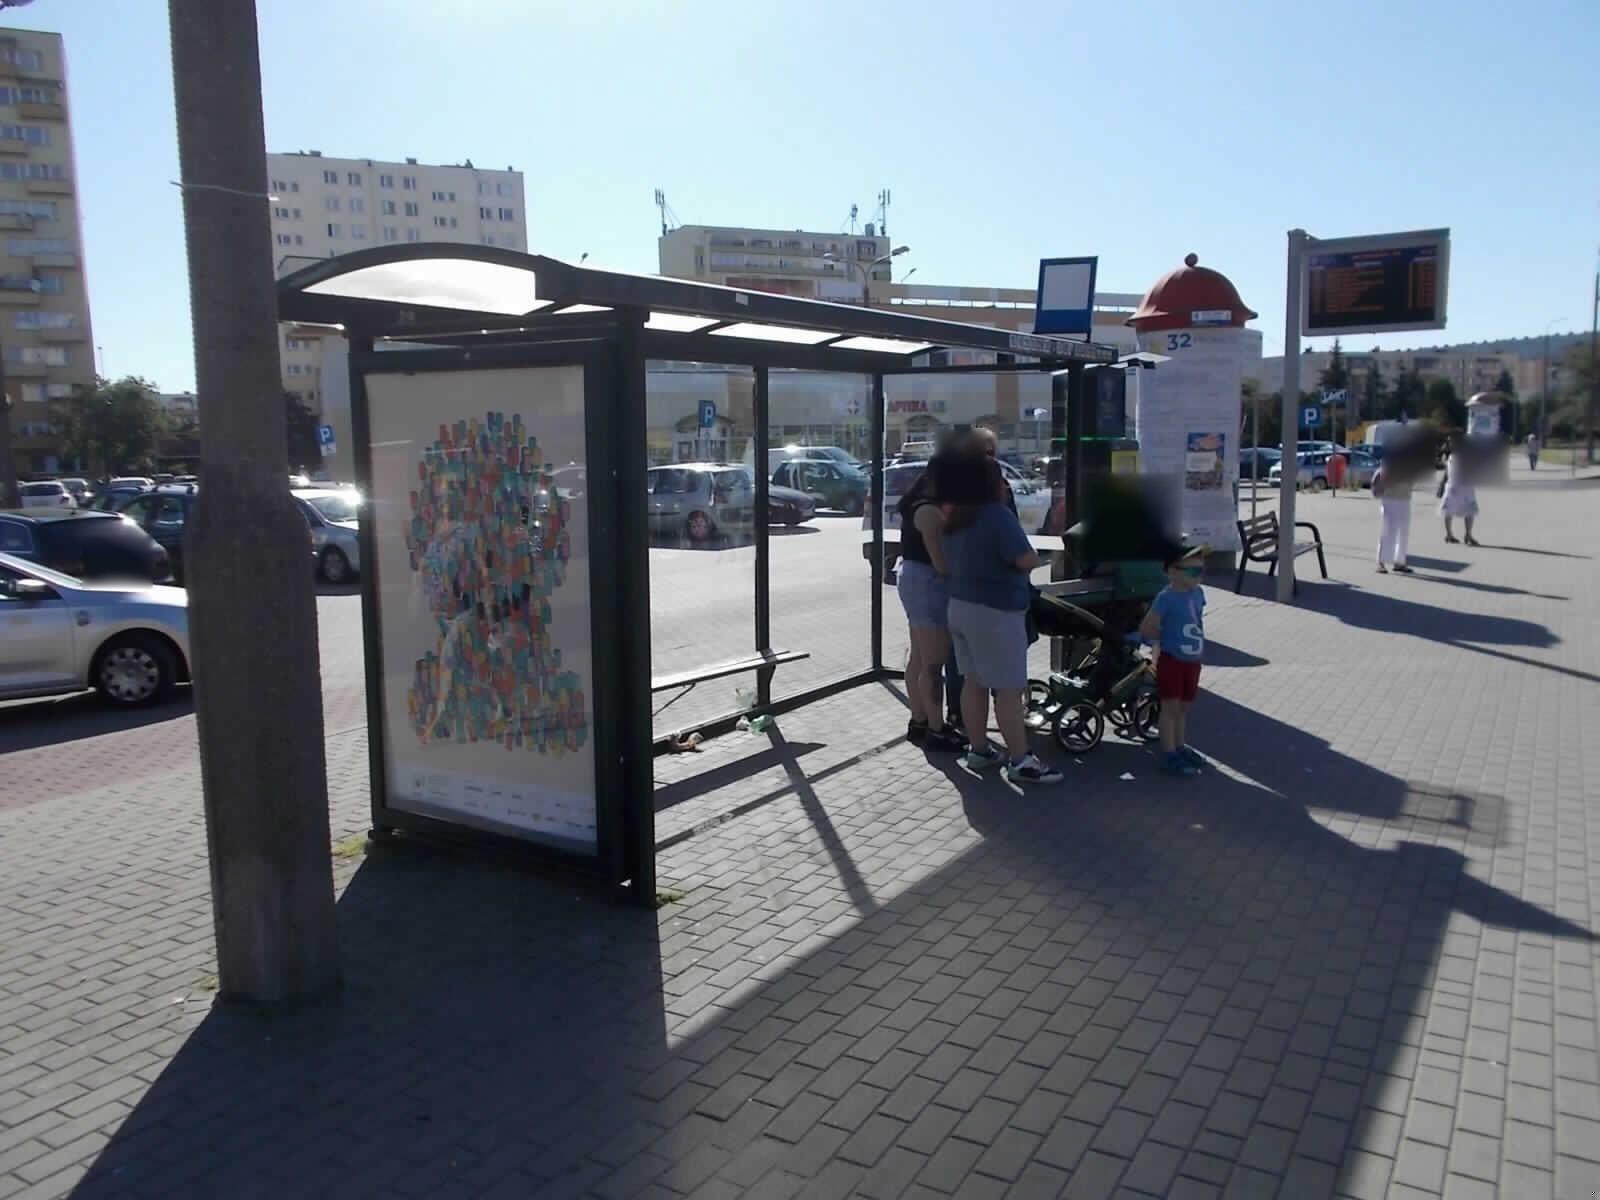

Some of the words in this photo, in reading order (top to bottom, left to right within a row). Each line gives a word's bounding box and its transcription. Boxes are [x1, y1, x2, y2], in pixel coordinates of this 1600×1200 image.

[1167, 332, 1192, 351] 32
[704, 405, 714, 424] P
[1303, 407, 1318, 425] P
[319, 427, 330, 443] P
[1181, 623, 1204, 656] S
